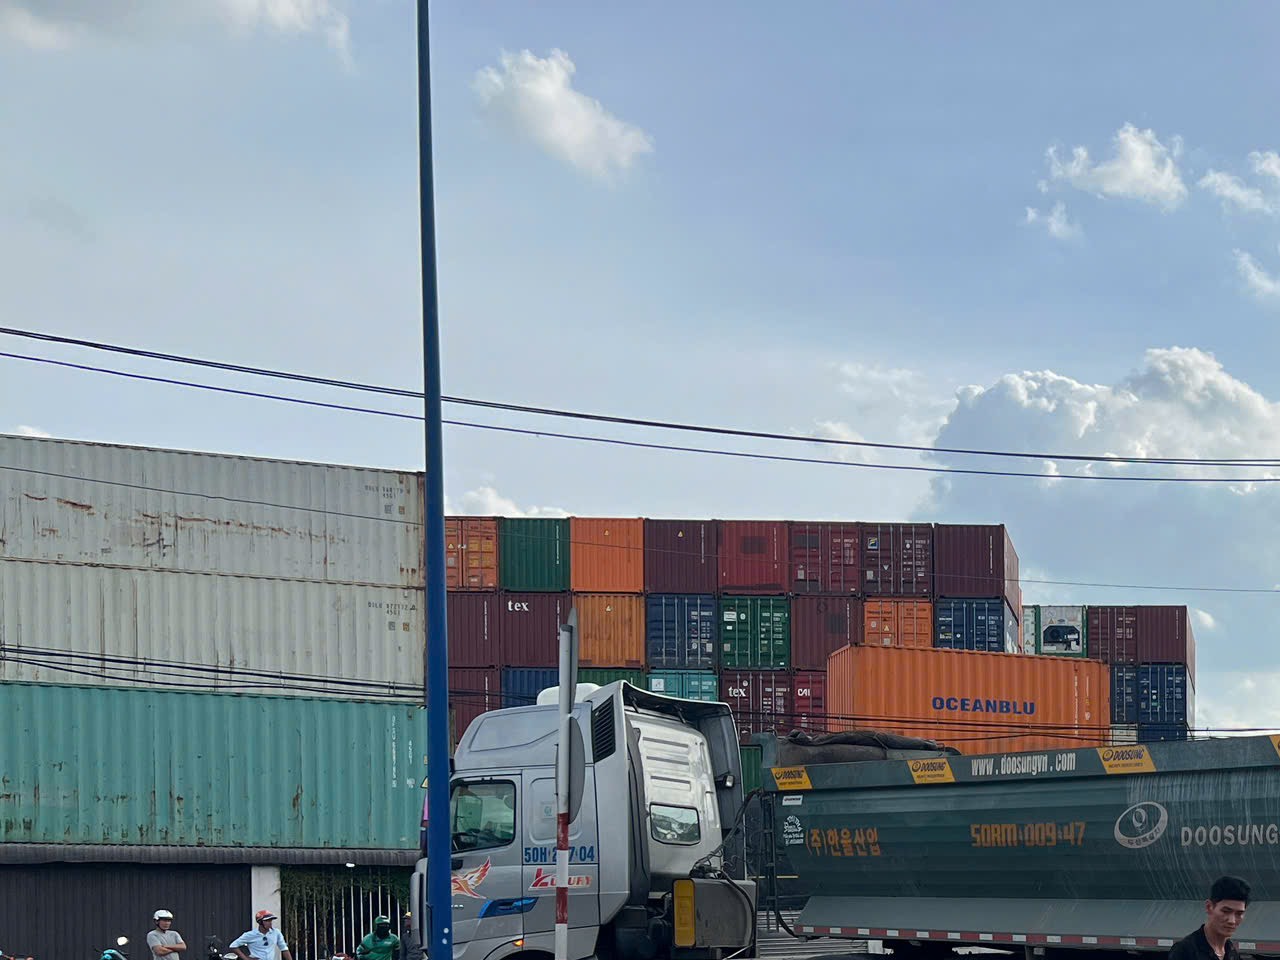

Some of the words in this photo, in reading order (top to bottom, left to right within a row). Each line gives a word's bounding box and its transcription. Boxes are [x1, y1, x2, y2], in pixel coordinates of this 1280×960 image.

[507, 600, 529, 611] tex
[728, 686, 746, 697] tex
[797, 688, 811, 697] CAI
[932, 697, 1035, 715] OCEANBLU
[1180, 824, 1279, 847] DOOSUNG
